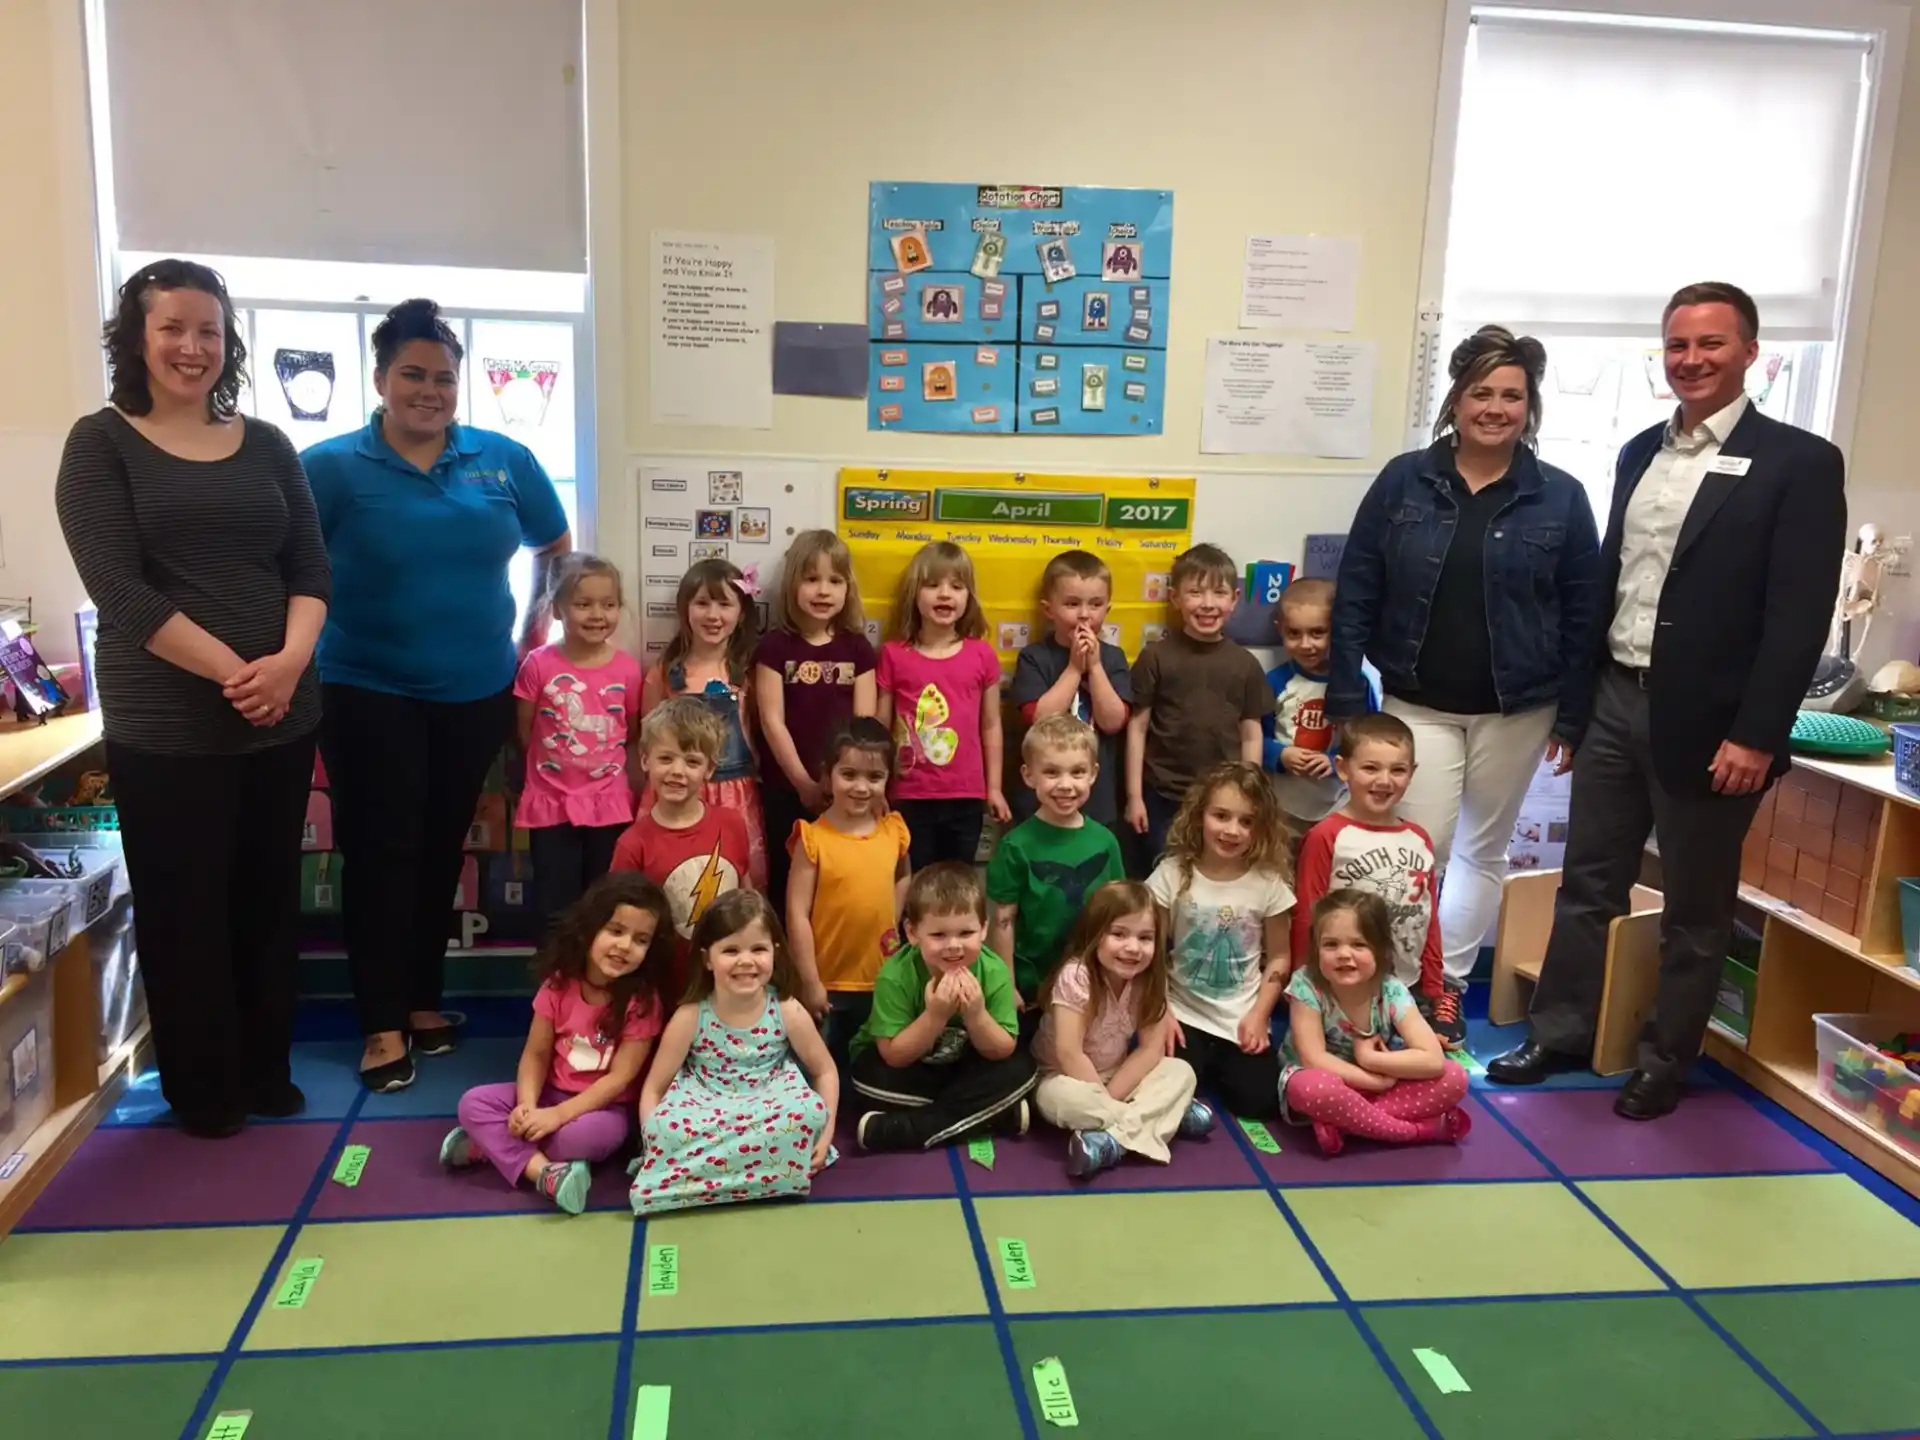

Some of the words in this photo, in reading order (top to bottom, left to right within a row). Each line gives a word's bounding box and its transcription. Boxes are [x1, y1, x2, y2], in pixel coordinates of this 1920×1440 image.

[980, 190, 1025, 202] Rotation
[1029, 191, 1059, 202] Chart
[663, 255, 672, 265] If
[675, 256, 702, 266] You're
[705, 257, 733, 268] Happy
[662, 267, 679, 275] and
[680, 267, 697, 277] You
[699, 268, 721, 277] Know
[854, 495, 921, 513] Spring
[992, 501, 1051, 520] April
[1119, 504, 1178, 521] 2017
[848, 529, 880, 540] Sunday
[896, 530, 932, 541] Monday
[946, 531, 982, 543] Tuesday
[988, 532, 1037, 545] Wednesday
[1042, 534, 1081, 546] Thursday
[1096, 536, 1123, 548] Friday
[1139, 540, 1177, 550] Saturday
[1266, 572, 1283, 603] 20
[868, 623, 876, 634] 2
[1110, 627, 1118, 637] 7
[784, 660, 856, 685] LOVE
[1335, 846, 1393, 887] SOUTH
[651, 1247, 677, 1291] Hayden
[1005, 1242, 1031, 1282] Kaden
